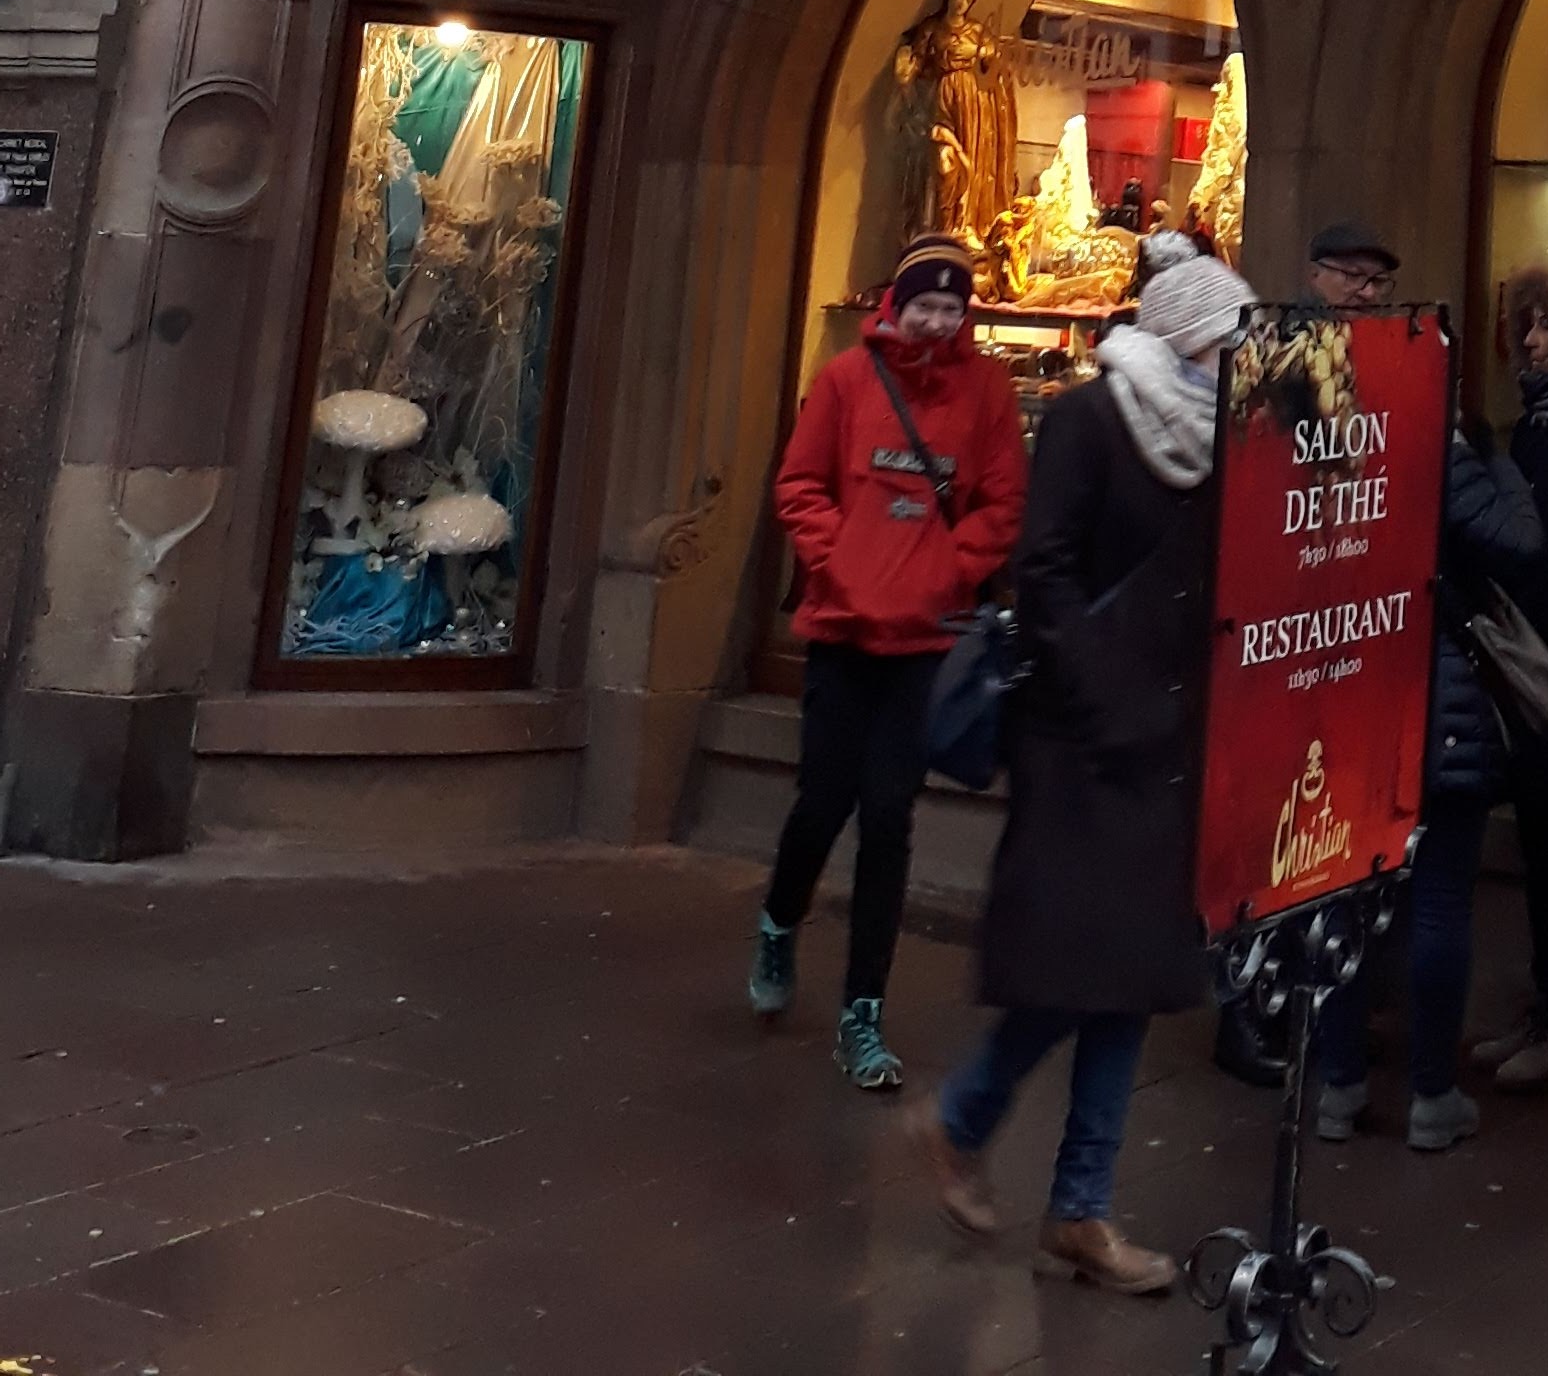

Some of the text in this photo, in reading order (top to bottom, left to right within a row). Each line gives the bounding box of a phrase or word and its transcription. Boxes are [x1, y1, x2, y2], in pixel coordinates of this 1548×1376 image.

[1292, 411, 1390, 465] SALON
[1282, 465, 1389, 535] DE THÉ
[1240, 591, 1412, 666] RESTAURANT
[1271, 778, 1351, 888] Christian
